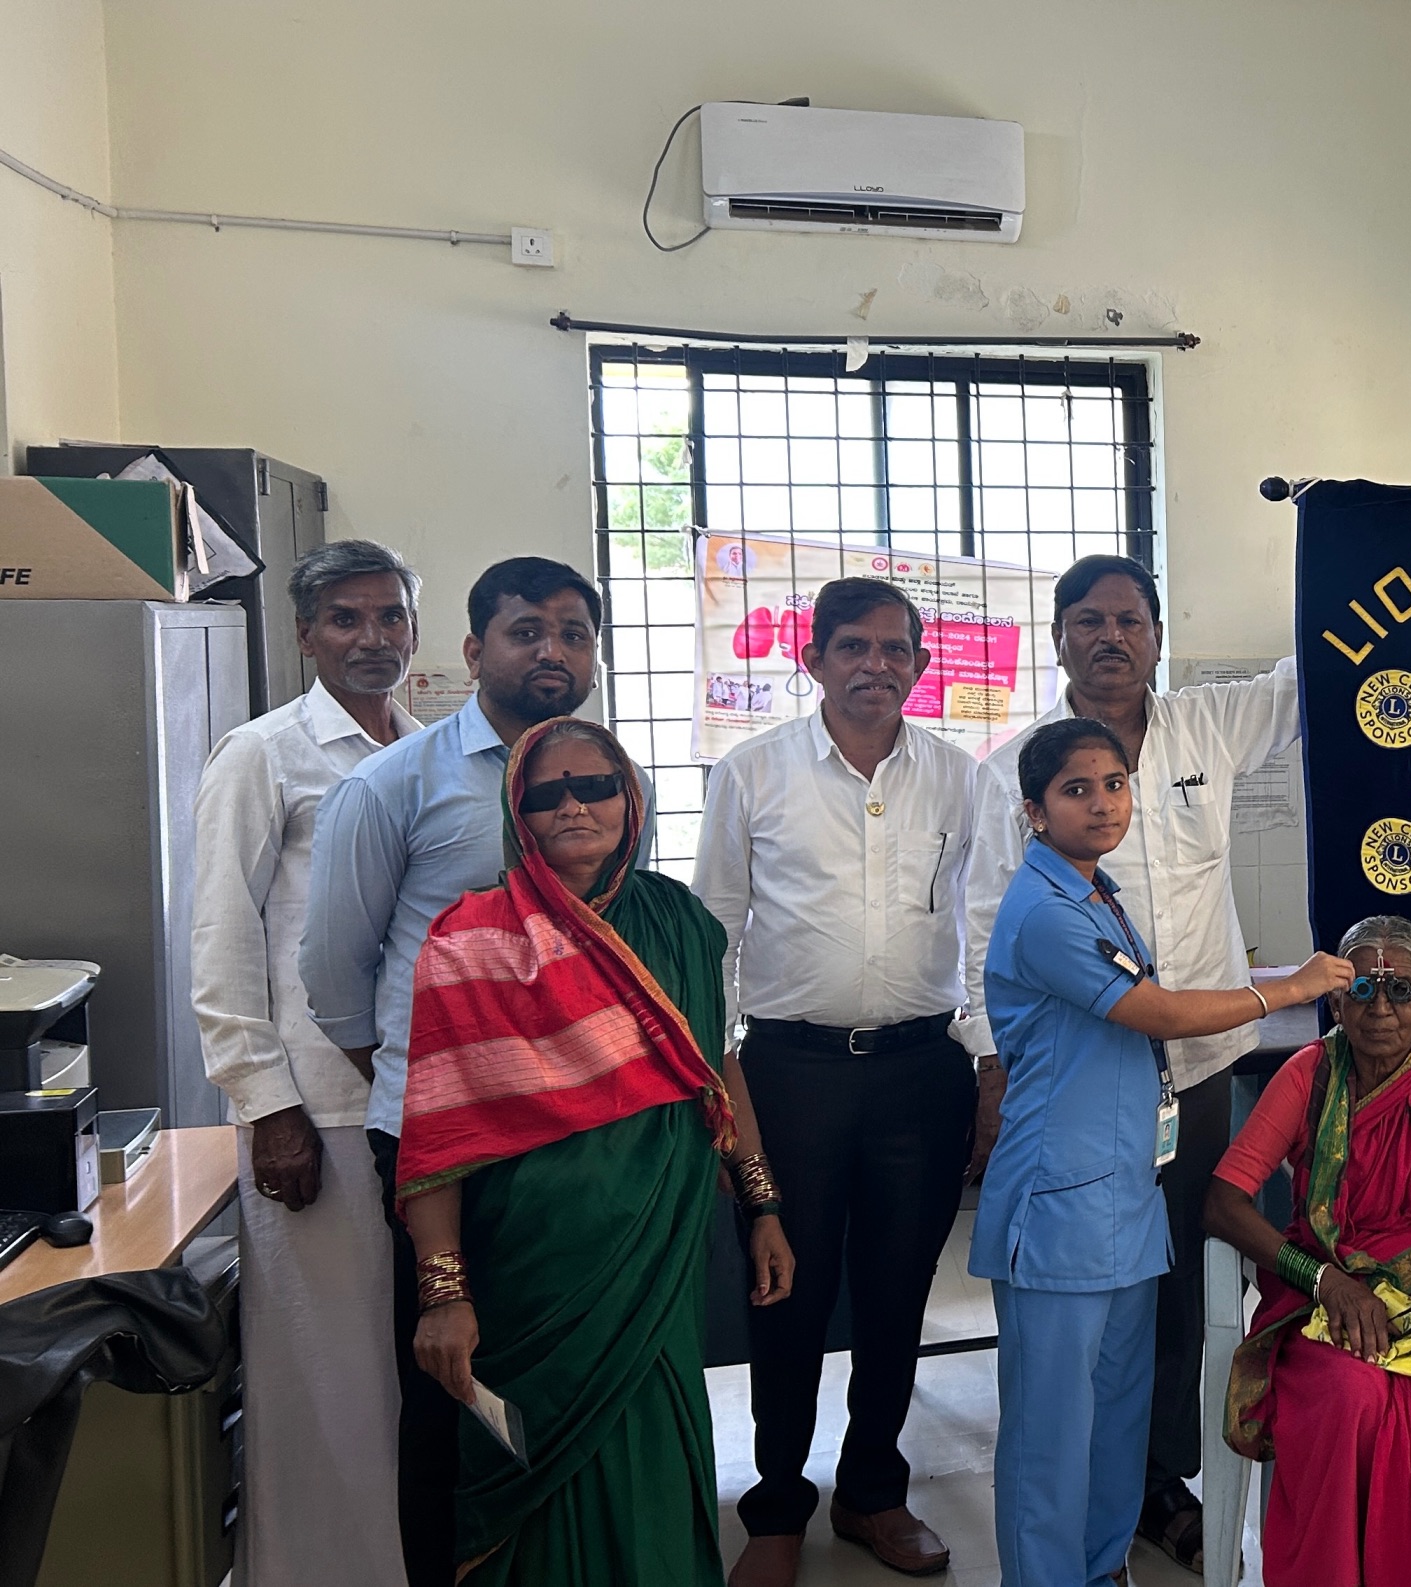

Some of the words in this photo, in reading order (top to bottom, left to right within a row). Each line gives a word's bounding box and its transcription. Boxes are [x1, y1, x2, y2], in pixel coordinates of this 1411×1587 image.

[0, 568, 32, 585] FE
[940, 610, 1015, 628] ಆಂದೋಲನ
[1360, 673, 1391, 704] NEW
[1382, 686, 1411, 699] LIONS
[1388, 698, 1400, 715] L
[1365, 821, 1393, 849] NEW
[1386, 833, 1411, 847] LIONS
[1392, 845, 1403, 861] L
